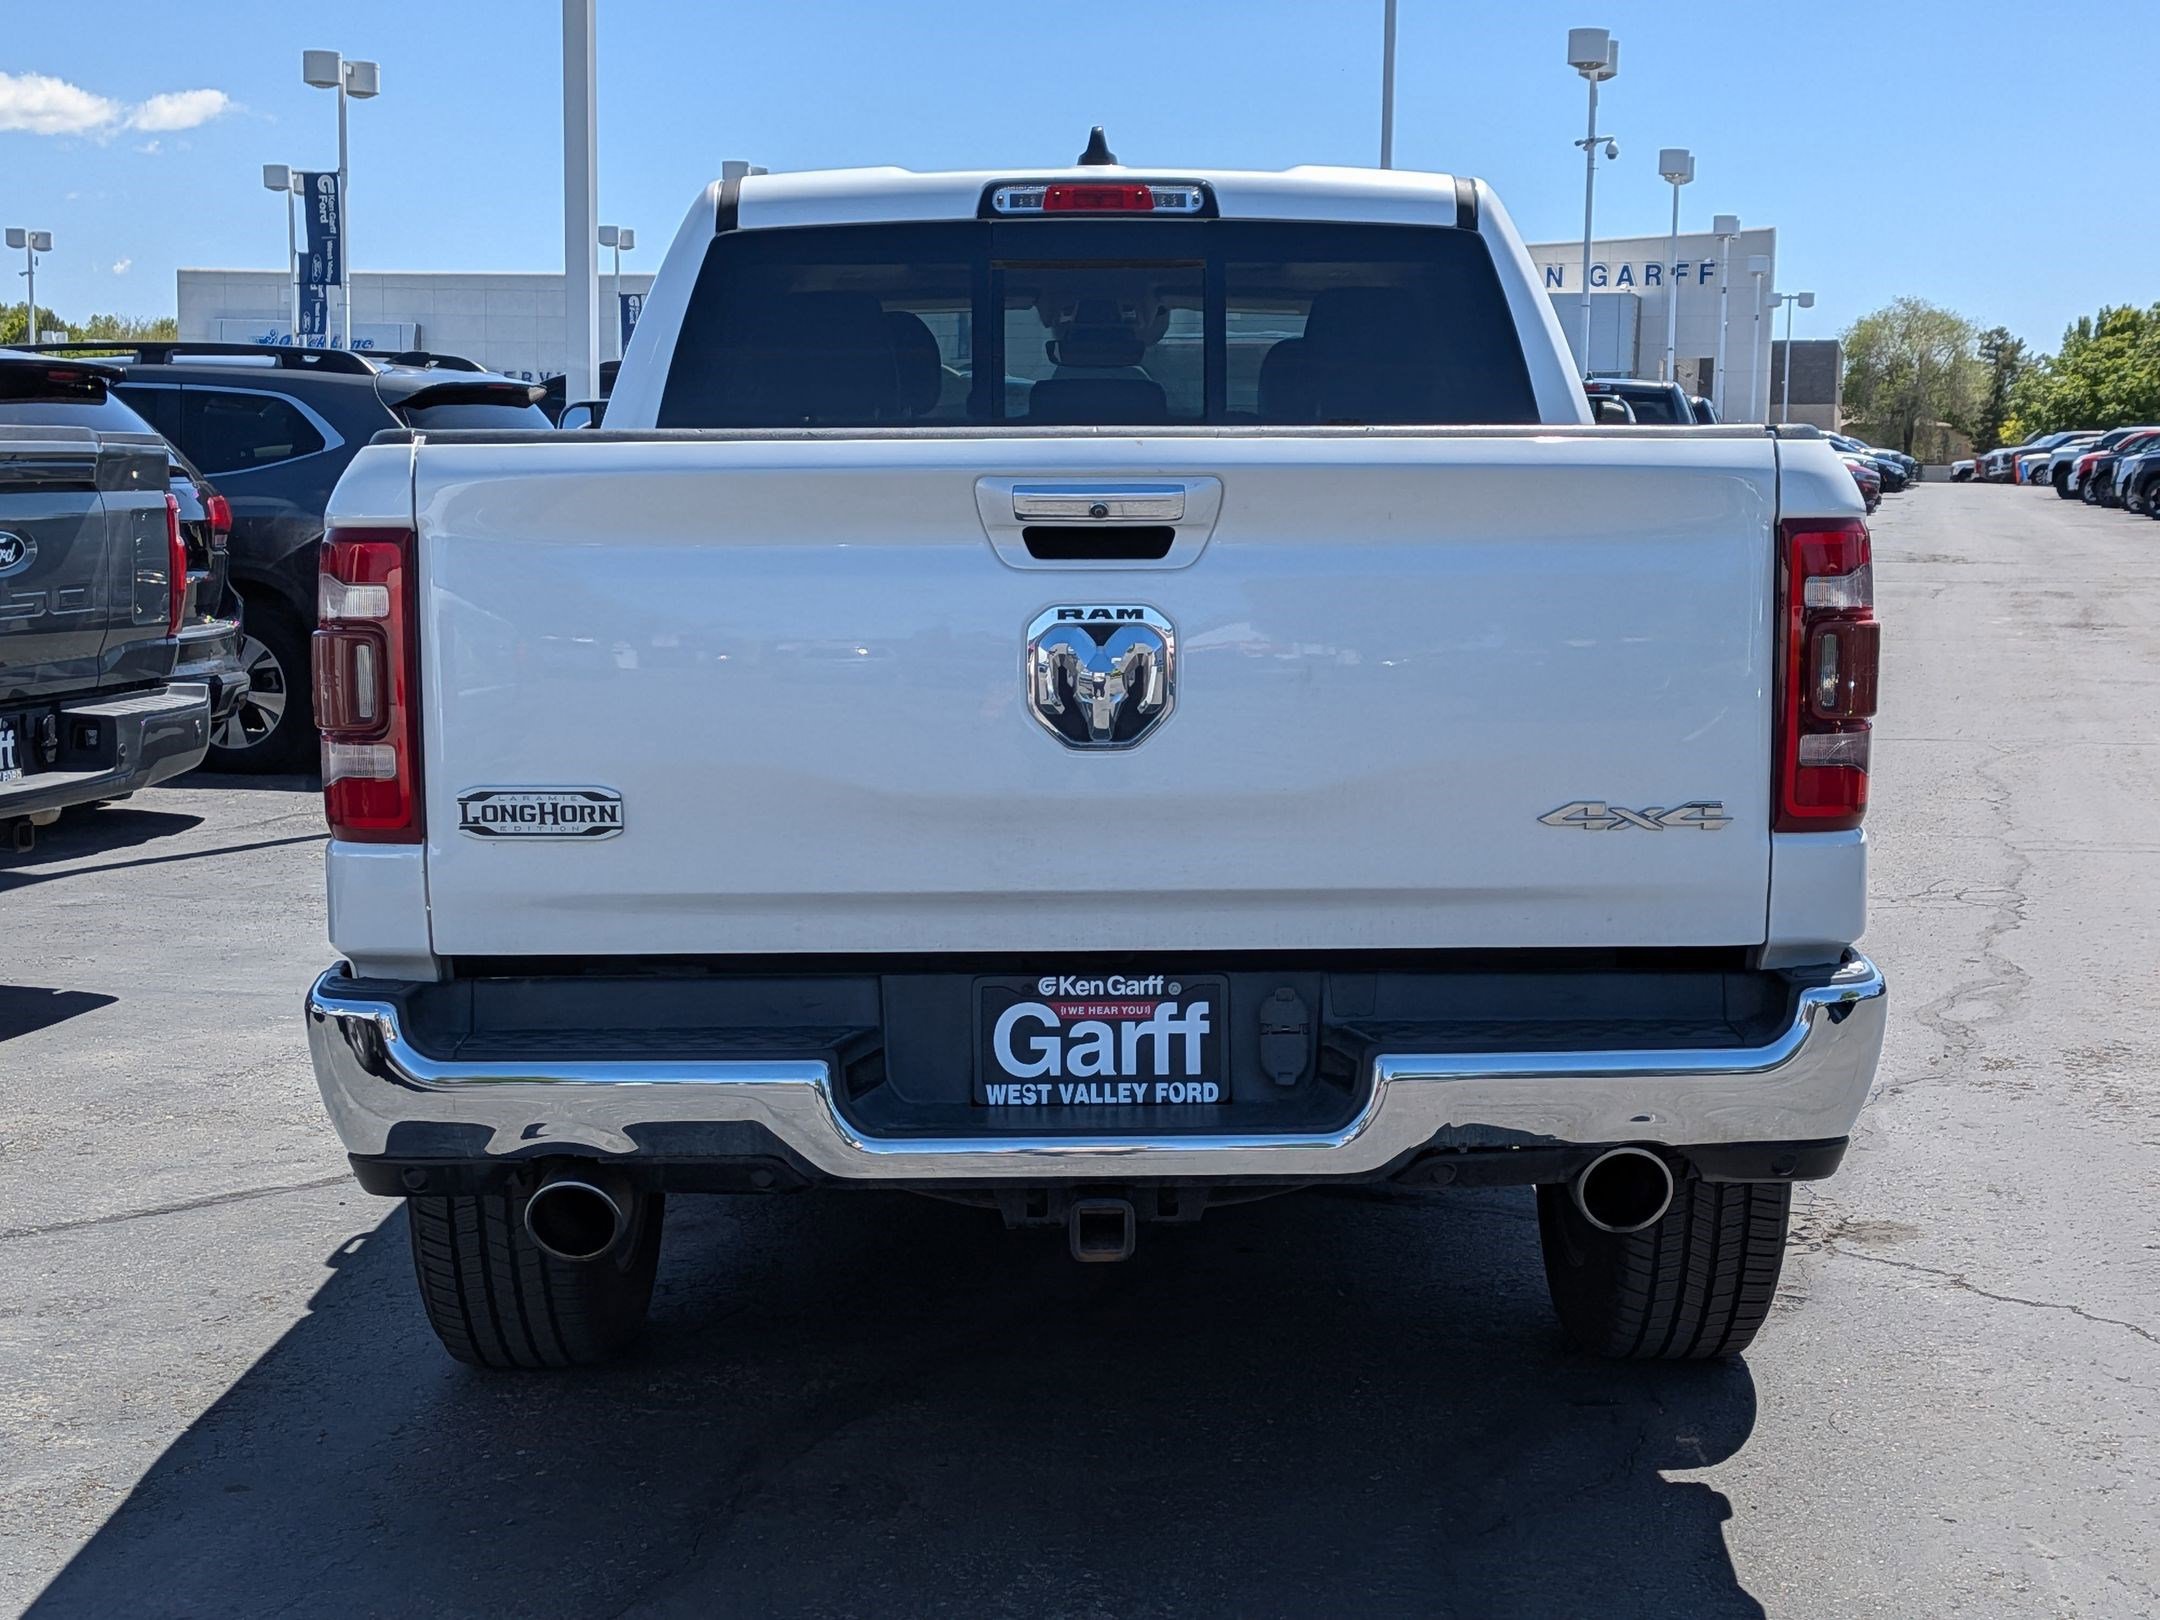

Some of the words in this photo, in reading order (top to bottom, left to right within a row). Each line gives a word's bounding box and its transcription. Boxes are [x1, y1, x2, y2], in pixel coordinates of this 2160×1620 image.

[318, 194, 329, 224] Ford
[328, 194, 336, 212] Ken
[328, 211, 337, 234] Garff
[1589, 262, 1716, 288] GARFF
[1057, 608, 1144, 620] RAM
[1059, 976, 1104, 996] Ken
[1107, 975, 1164, 996] Garff
[1068, 1006, 1085, 1015] WE
[1088, 1006, 1118, 1015] HEAR
[1121, 1006, 1144, 1015] YOU
[994, 1001, 1210, 1078] Garff
[985, 1084, 1052, 1105] WEST
[1059, 1082, 1148, 1105] VALLEY
[1155, 1082, 1219, 1104] FORD
